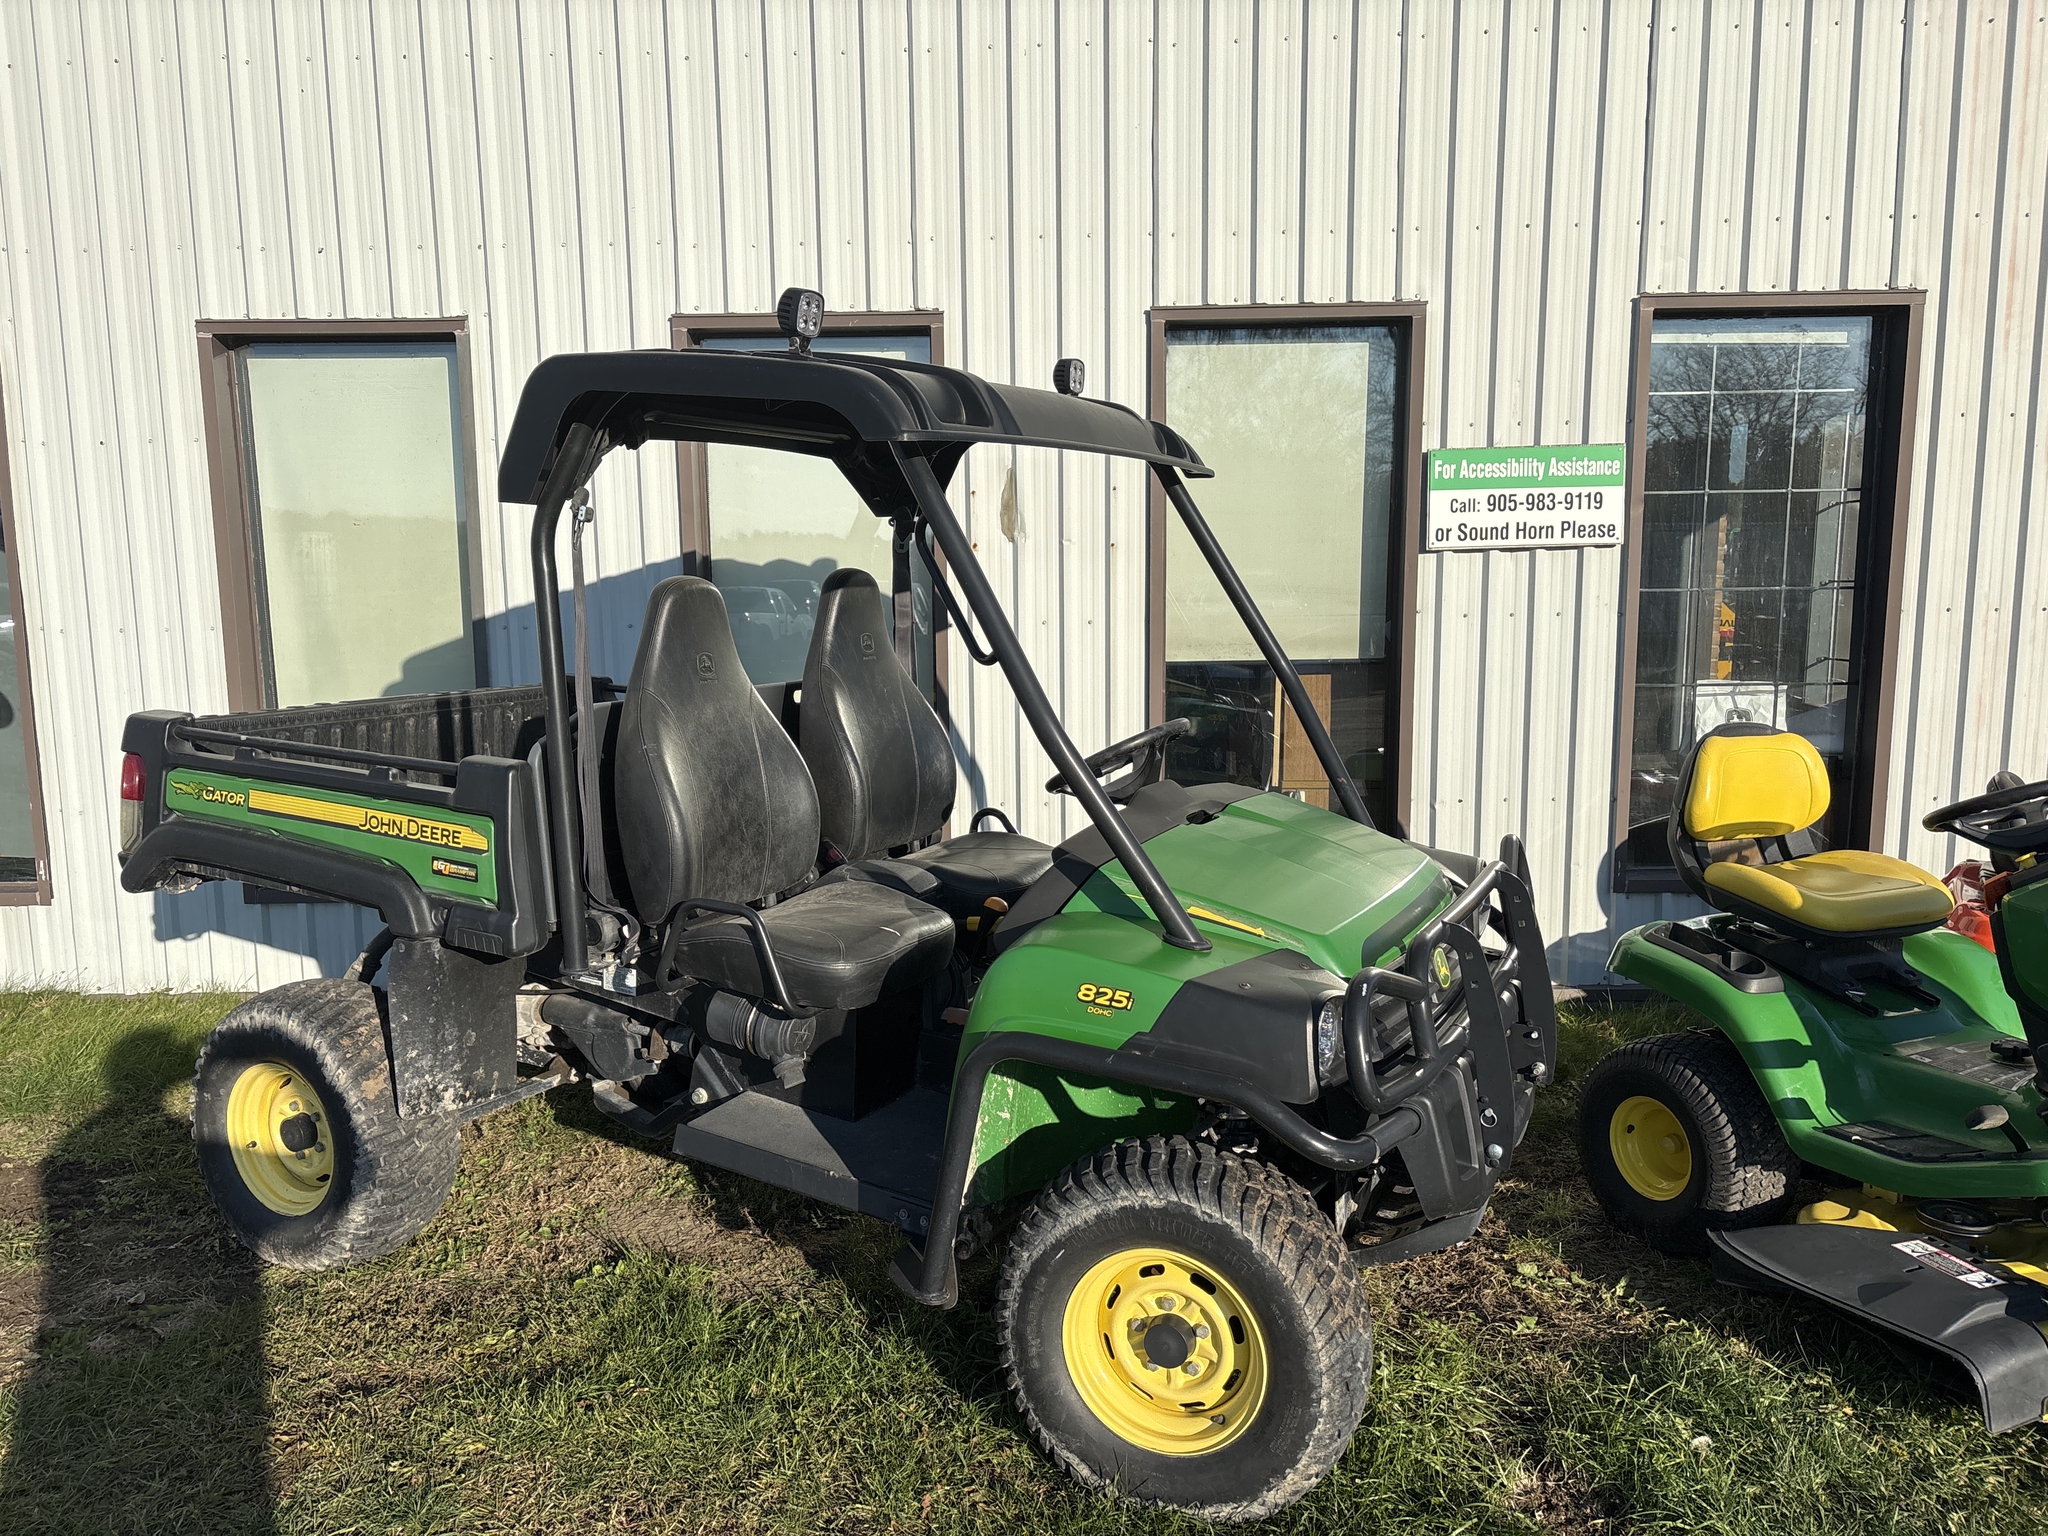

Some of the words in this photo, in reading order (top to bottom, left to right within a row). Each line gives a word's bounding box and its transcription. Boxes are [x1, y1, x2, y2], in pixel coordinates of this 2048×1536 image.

[1434, 459, 1456, 479] For
[1459, 457, 1545, 481] Accessibility
[1548, 456, 1621, 477] Assistance
[1450, 497, 1481, 513] Call:
[1487, 491, 1603, 512] 905-983-9119
[1435, 526, 1452, 542] or
[1457, 522, 1510, 541] Sound
[1515, 522, 1554, 540] Horn
[1561, 520, 1616, 539] Please
[203, 787, 246, 806] GATOR
[359, 811, 404, 834] JOHN
[406, 822, 462, 846] DEERE
[1077, 983, 1134, 1010] 825i
[1087, 1006, 1112, 1017] DOHC
